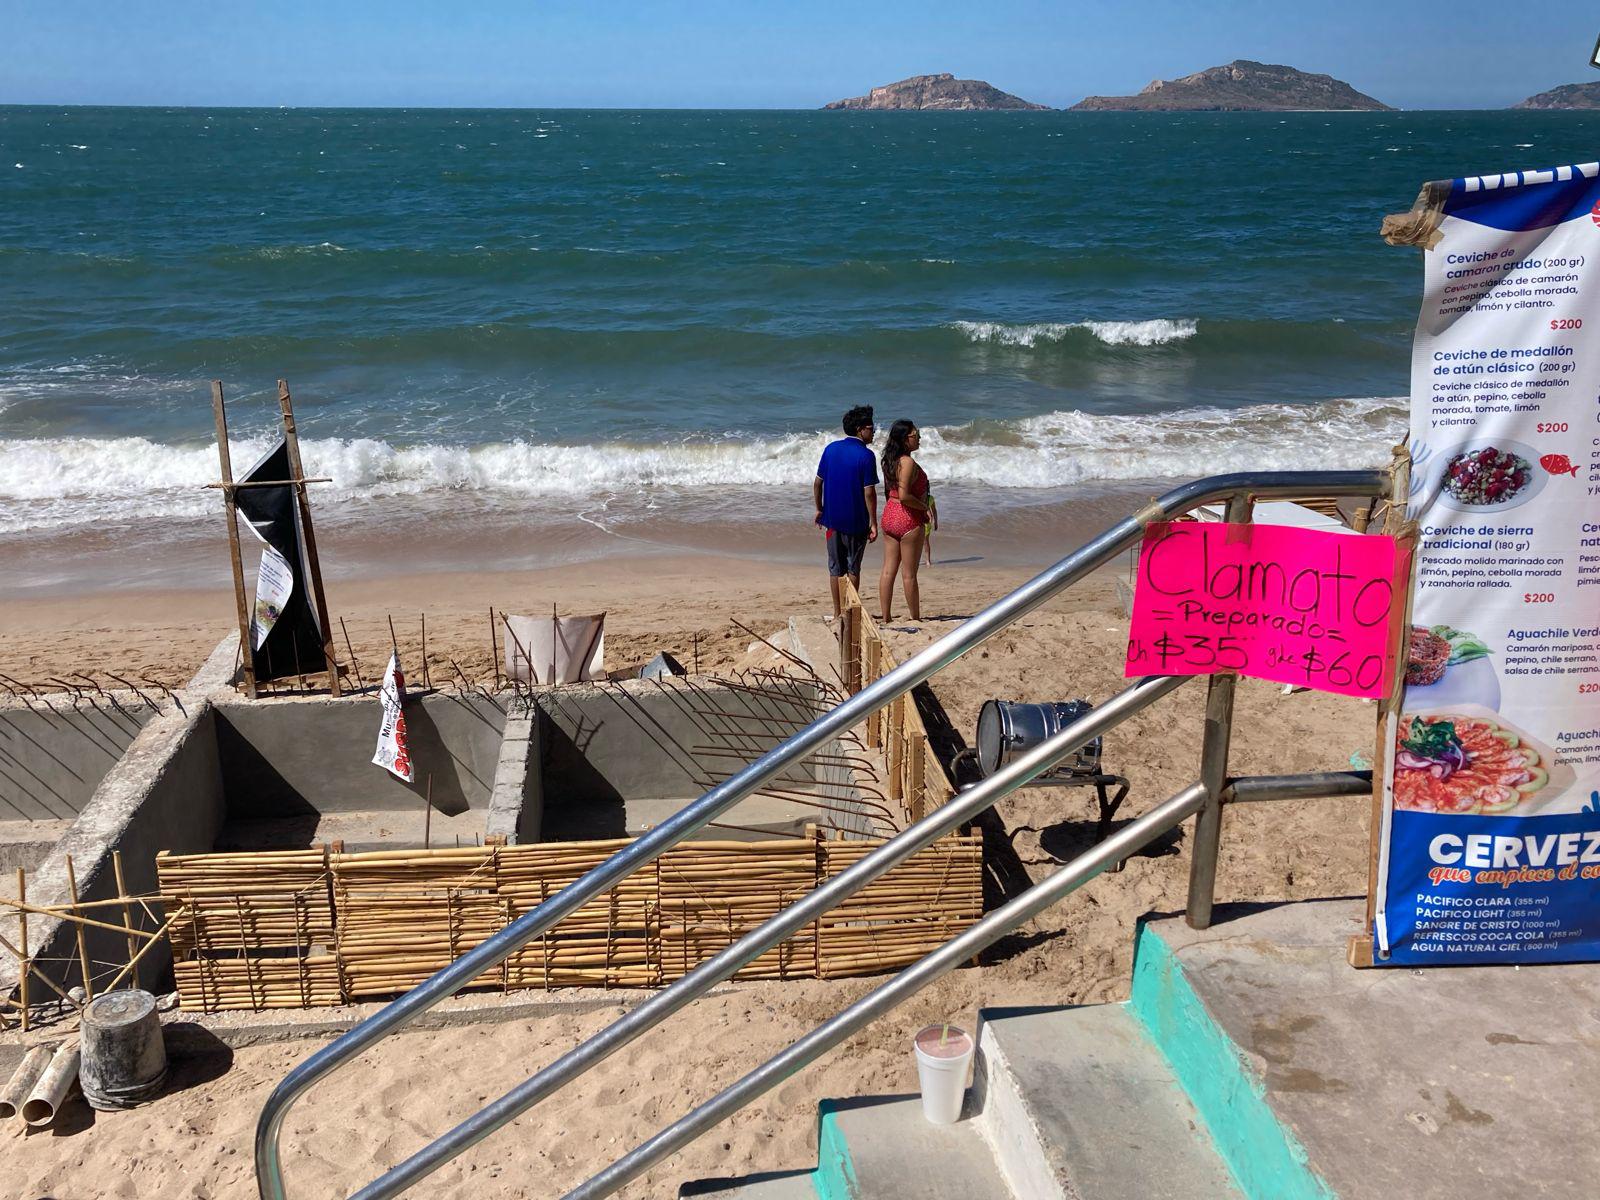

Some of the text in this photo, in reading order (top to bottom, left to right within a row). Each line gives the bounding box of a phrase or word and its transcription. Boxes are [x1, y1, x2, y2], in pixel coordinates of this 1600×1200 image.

[1447, 247, 1515, 265] Ceviche de
[1446, 255, 1585, 279] camaron crudo (200 gr)
[1444, 272, 1579, 294] Ceviche clásico de camarón
[1442, 285, 1579, 305] con pepino, cebolla morada,
[1439, 299, 1555, 315] tomate, limón y cilantro.
[1550, 319, 1582, 331] $200
[1433, 345, 1574, 362] Ceviche de medallón
[1433, 361, 1576, 375] de atún clásico (200 gr)
[1433, 377, 1570, 391] Ceviche clásico de medallón
[1432, 390, 1546, 403] de atún, pepino, cebolla
[1432, 402, 1540, 415] morada, tomate, limón
[1431, 416, 1478, 428] y cilantro.
[1536, 421, 1569, 434] $200
[1423, 525, 1534, 537] Ceviche de sierra
[1423, 538, 1530, 551] tradicional (180 gr)
[1422, 556, 1564, 565] Pescado molido marinado con
[1579, 554, 1600, 562] Pesc
[1147, 530, 1393, 627] Clamato
[1421, 566, 1562, 579] limón, pepino, cebolla morada
[1420, 578, 1512, 589] y zanahoria rallada.
[1524, 592, 1555, 604] $200
[1507, 628, 1569, 642] Aguachile
[1506, 643, 1549, 652] Camarón
[1551, 643, 1594, 654] mariposa,
[1153, 630, 1249, 670] $35
[1303, 646, 1383, 690] $60
[1505, 655, 1597, 666] pepino, chile serrano,
[1504, 665, 1600, 675] salsa de chile serrano.
[1555, 745, 1593, 754] Camarón
[1554, 756, 1583, 766] pepino,
[1428, 866, 1472, 886] que
[1475, 864, 1555, 889] empiece
[1558, 859, 1578, 880] el
[1417, 893, 1550, 907] PACIFICO CLARA (355 ml)
[1416, 907, 1543, 918] PACIFICO LIGHT (355 ml)
[1415, 919, 1561, 930] SANGRE DE CRISTO (1000 ml)
[1413, 932, 1477, 941] REFRESCOS
[1479, 932, 1512, 941] COCA
[1515, 931, 1544, 940] COLA
[1411, 942, 1444, 952] AGUA
[1446, 944, 1497, 952] NATURAL
[1499, 943, 1521, 951] CIEL
[1544, 941, 1558, 950] ml)
